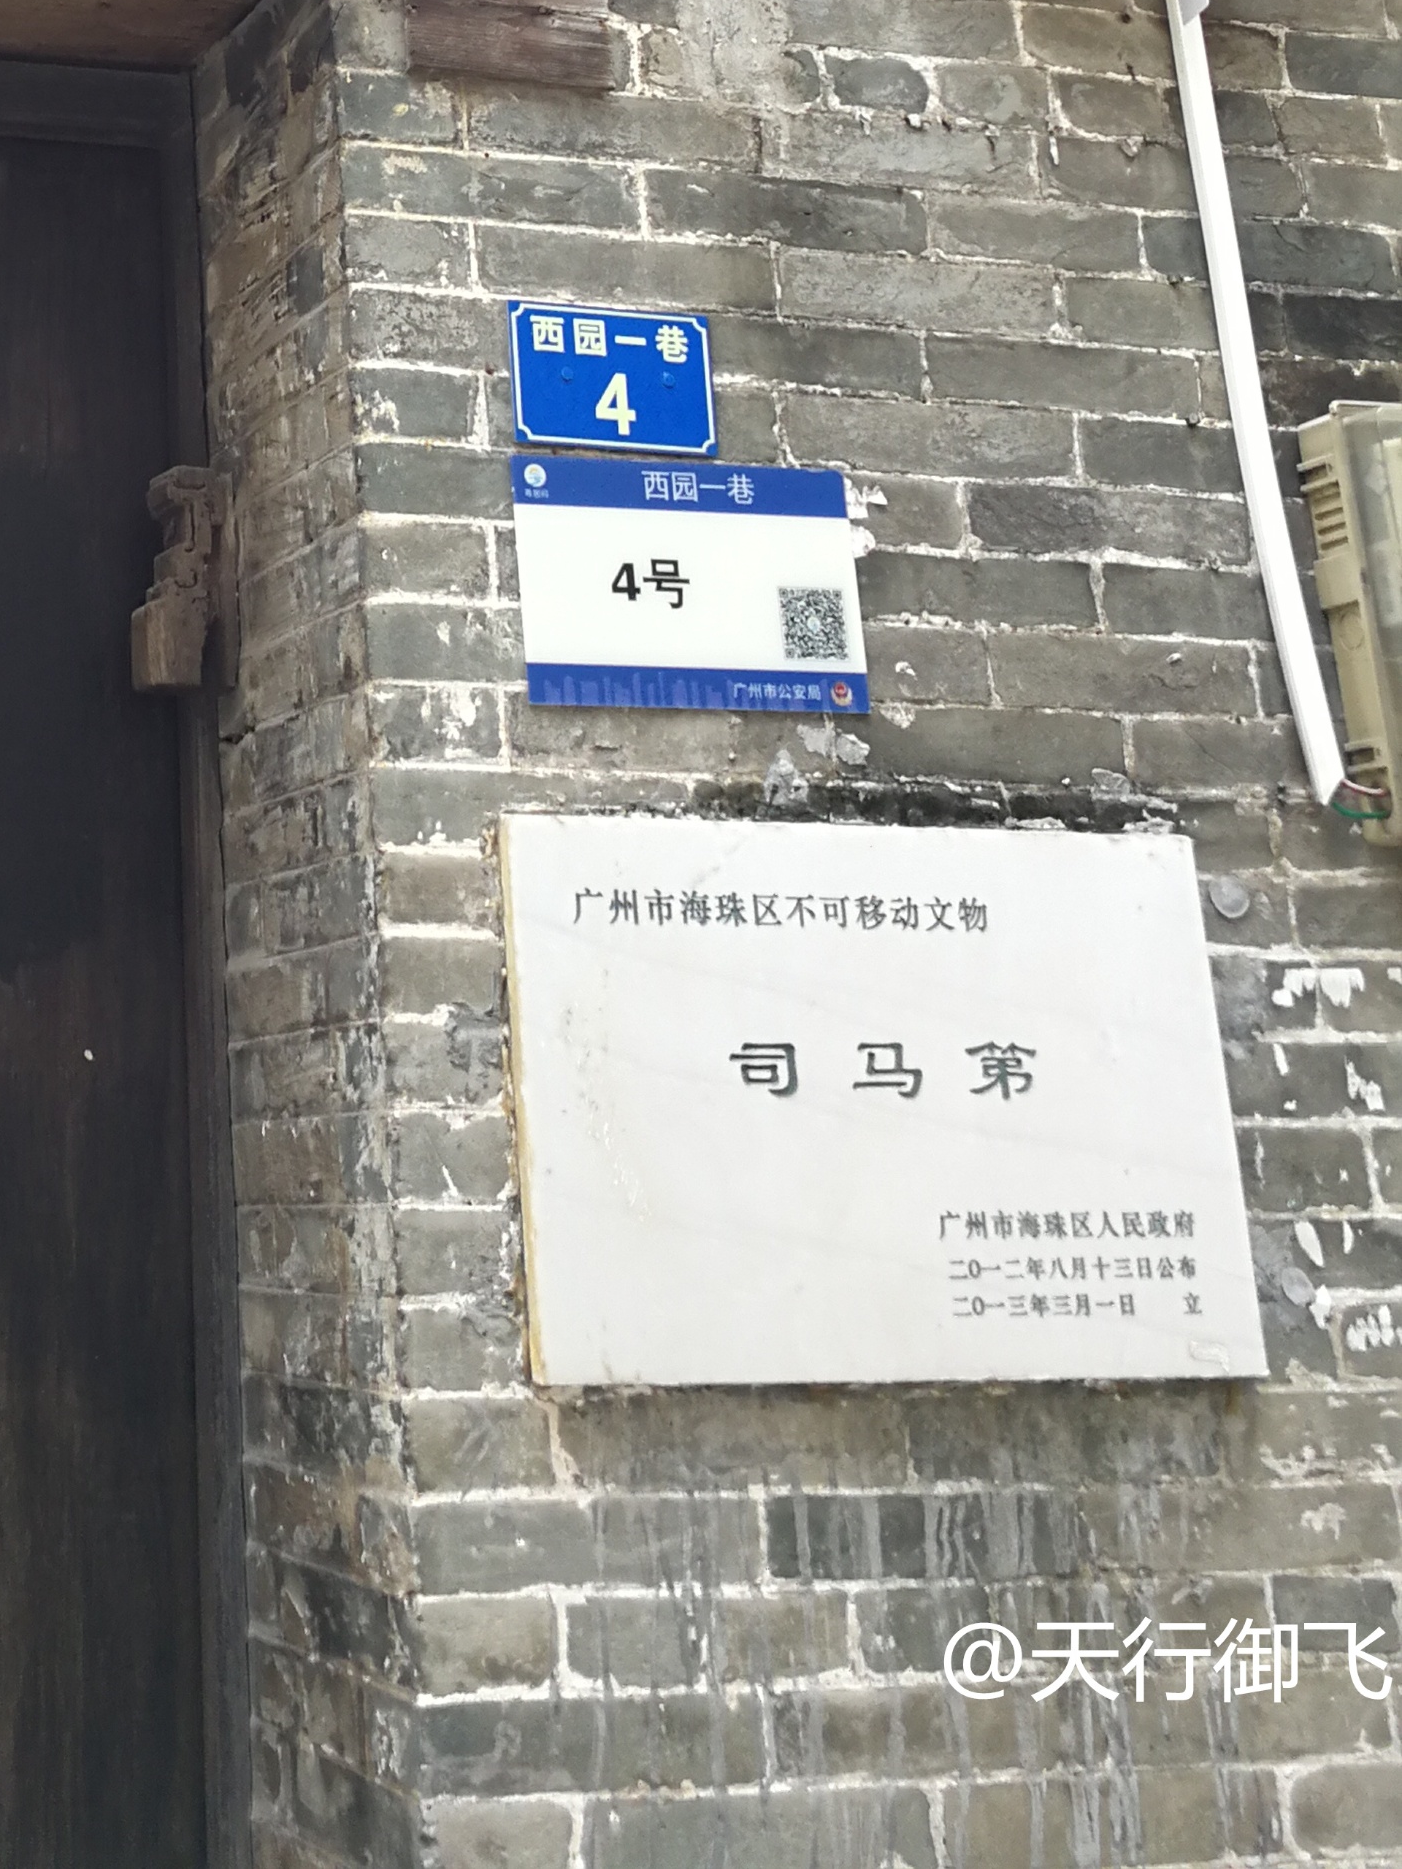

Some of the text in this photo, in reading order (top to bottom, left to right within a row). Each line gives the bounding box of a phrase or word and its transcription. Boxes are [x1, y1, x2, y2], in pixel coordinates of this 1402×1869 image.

[529, 314, 690, 364] 西园一巷
[594, 372, 636, 437] 4
[641, 470, 755, 506] 西园一巷
[611, 558, 690, 610] 4号
[733, 682, 822, 701] 广州市公安局
[572, 887, 989, 934] 广州市海珠区不可移动文物
[729, 1039, 1038, 1100] 司马第
[939, 1209, 1195, 1241] 广州市海珠区人民政府
